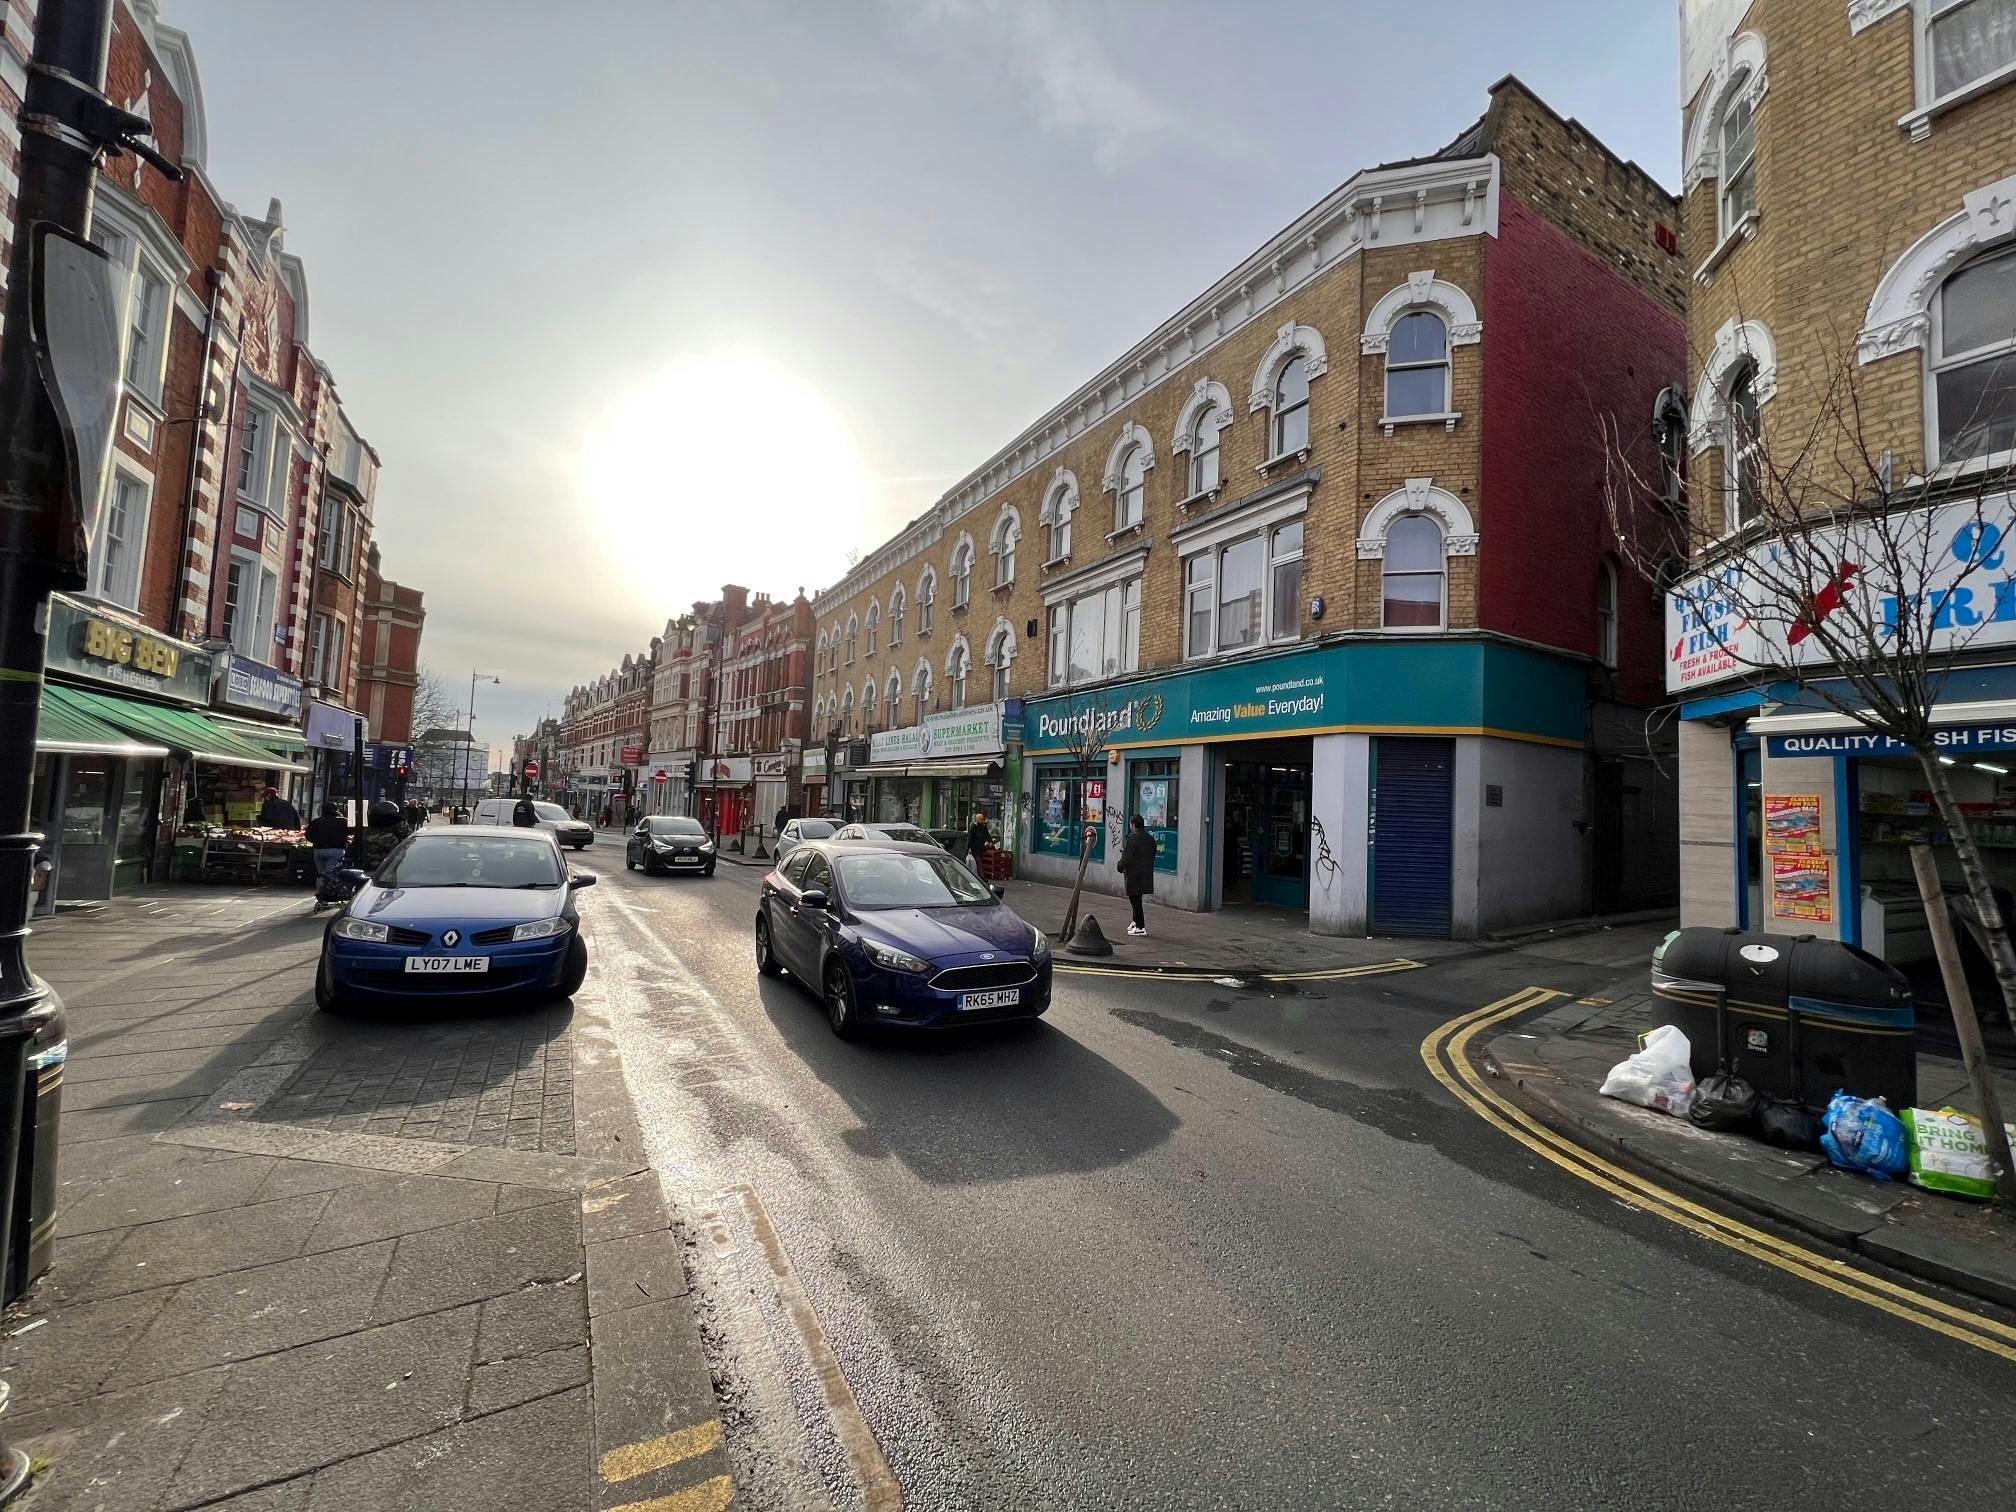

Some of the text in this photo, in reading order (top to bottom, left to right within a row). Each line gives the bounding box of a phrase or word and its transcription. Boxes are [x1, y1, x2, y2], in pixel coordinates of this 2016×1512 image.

[1681, 595, 1736, 633] FRESH
[84, 618, 180, 679] BIG BEN
[1688, 622, 1729, 655] FISH
[1680, 642, 1739, 671] FRESH & FROZEN
[106, 664, 157, 689] FISHERIES
[1680, 658, 1737, 682] FISH AVAILABLE
[250, 675, 273, 701] SEAFOOD
[1255, 675, 1323, 694] www.poundland.co.uk
[1038, 701, 1133, 738] Poundland
[1190, 693, 1324, 723] Amazing Value Everyday!
[933, 721, 989, 740] SUPERMARKET
[1784, 735, 1881, 751] QUALITY
[411, 958, 482, 971] LY07 LME
[965, 989, 1018, 1008] RK65 MHZ
[1917, 1123, 1976, 1141] BRING
[1919, 1135, 1936, 1147] IT
